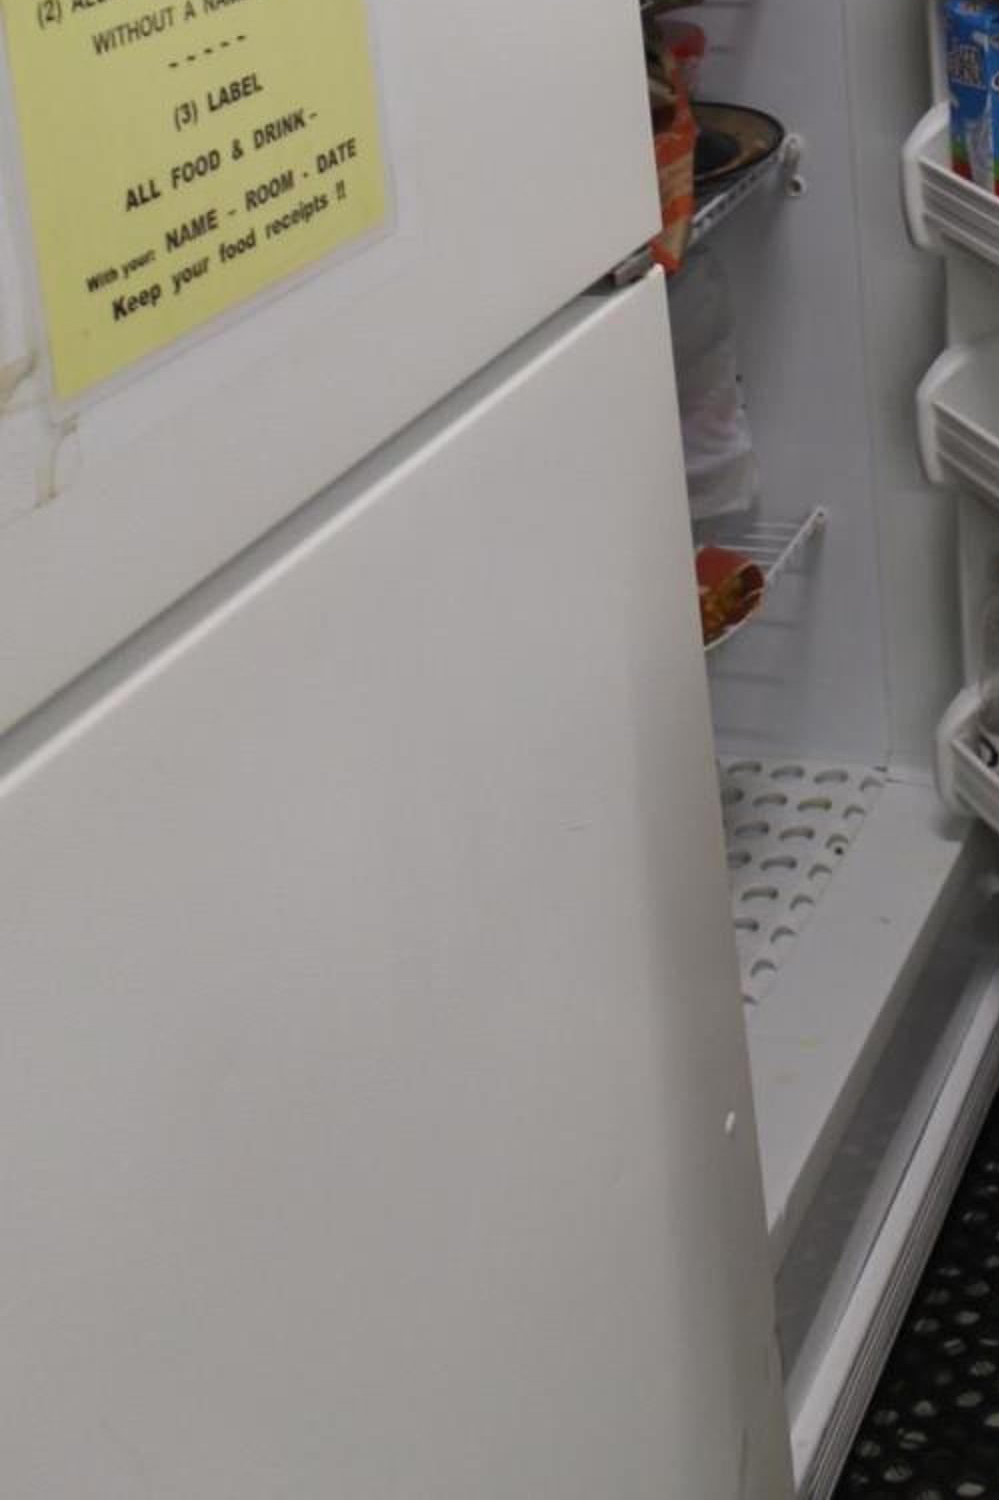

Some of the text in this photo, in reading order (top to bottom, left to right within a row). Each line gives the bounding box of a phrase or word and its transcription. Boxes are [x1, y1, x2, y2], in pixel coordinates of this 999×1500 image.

[92, 6, 176, 55] WITHOUT
[183, 0, 197, 21] A
[174, 73, 264, 132] (3) LABEL
[125, 179, 161, 212] ALL
[170, 149, 221, 189] FOOD
[231, 139, 244, 161] &
[85, 267, 119, 293] With
[165, 208, 219, 252] NAME
[245, 169, 295, 211] ROOM
[316, 137, 357, 174] DATE
[111, 283, 162, 321] Keep
[171, 256, 210, 295] your
[218, 228, 257, 263] food
[264, 193, 330, 239] receipts
